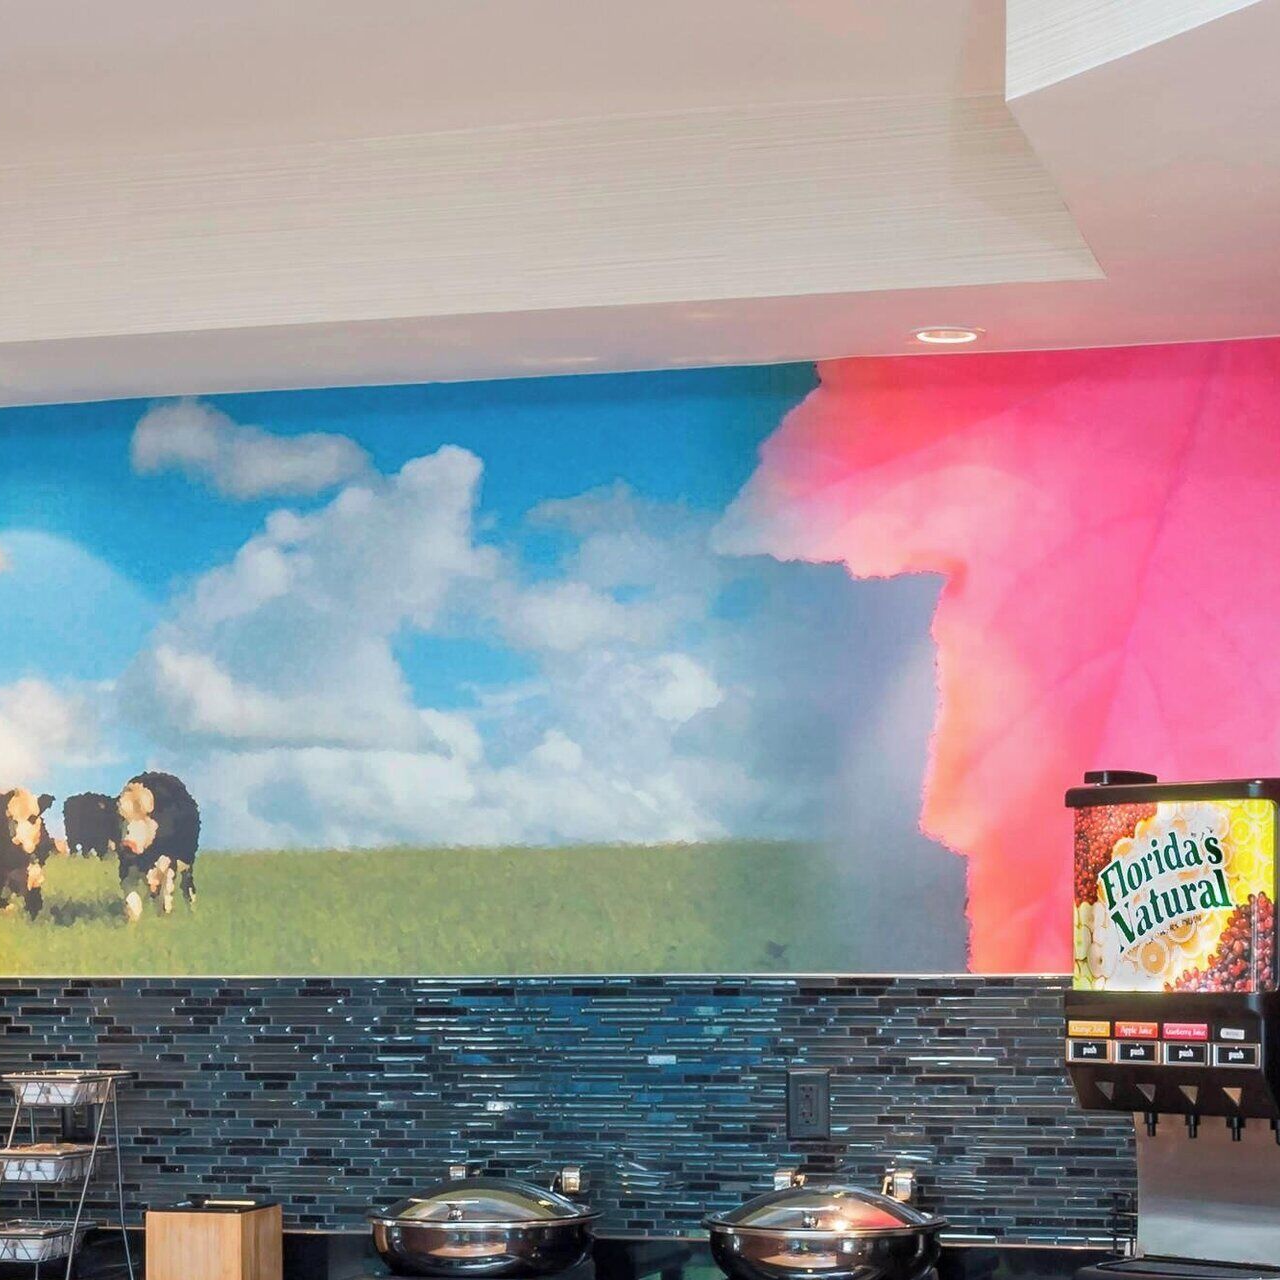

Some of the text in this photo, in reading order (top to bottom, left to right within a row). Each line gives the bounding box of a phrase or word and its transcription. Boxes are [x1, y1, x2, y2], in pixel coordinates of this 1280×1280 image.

[1120, 1025, 1153, 1036] Apple Juice
[1083, 1045, 1097, 1056] push
[1130, 1047, 1145, 1058] push
[1179, 1048, 1194, 1059] push
[1228, 1050, 1244, 1061] push
